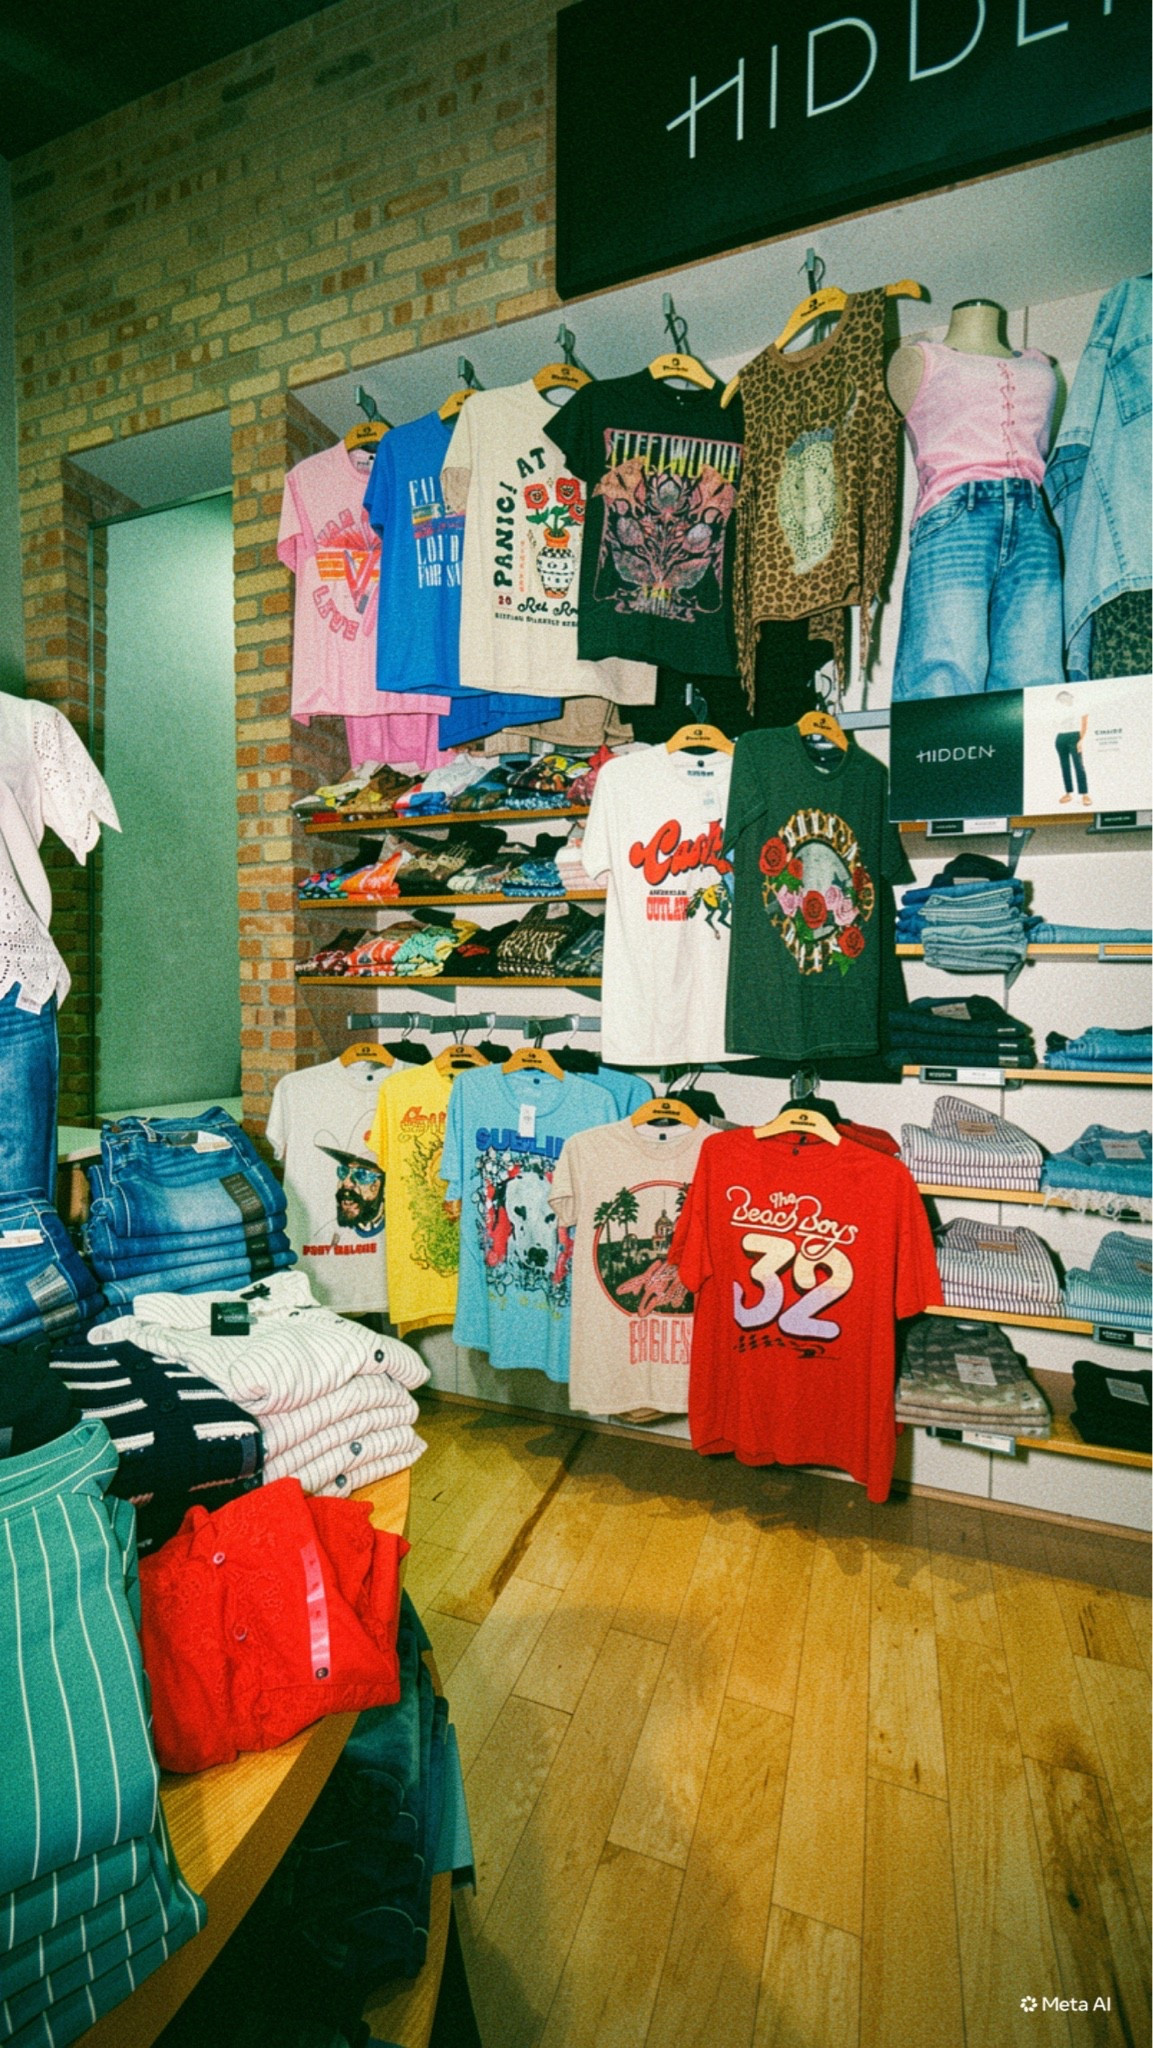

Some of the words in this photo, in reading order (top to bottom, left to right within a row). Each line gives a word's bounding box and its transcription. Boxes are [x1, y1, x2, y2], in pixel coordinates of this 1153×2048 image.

[666, 0, 1112, 159] HIDD
[493, 481, 518, 588] PANIC!
[516, 447, 546, 479] AT
[915, 744, 996, 763] HIDDEN
[726, 1185, 798, 1233] Beach
[795, 1195, 859, 1260] Boys
[733, 1232, 854, 1342] 32
[629, 1318, 691, 1366] EAGLES
